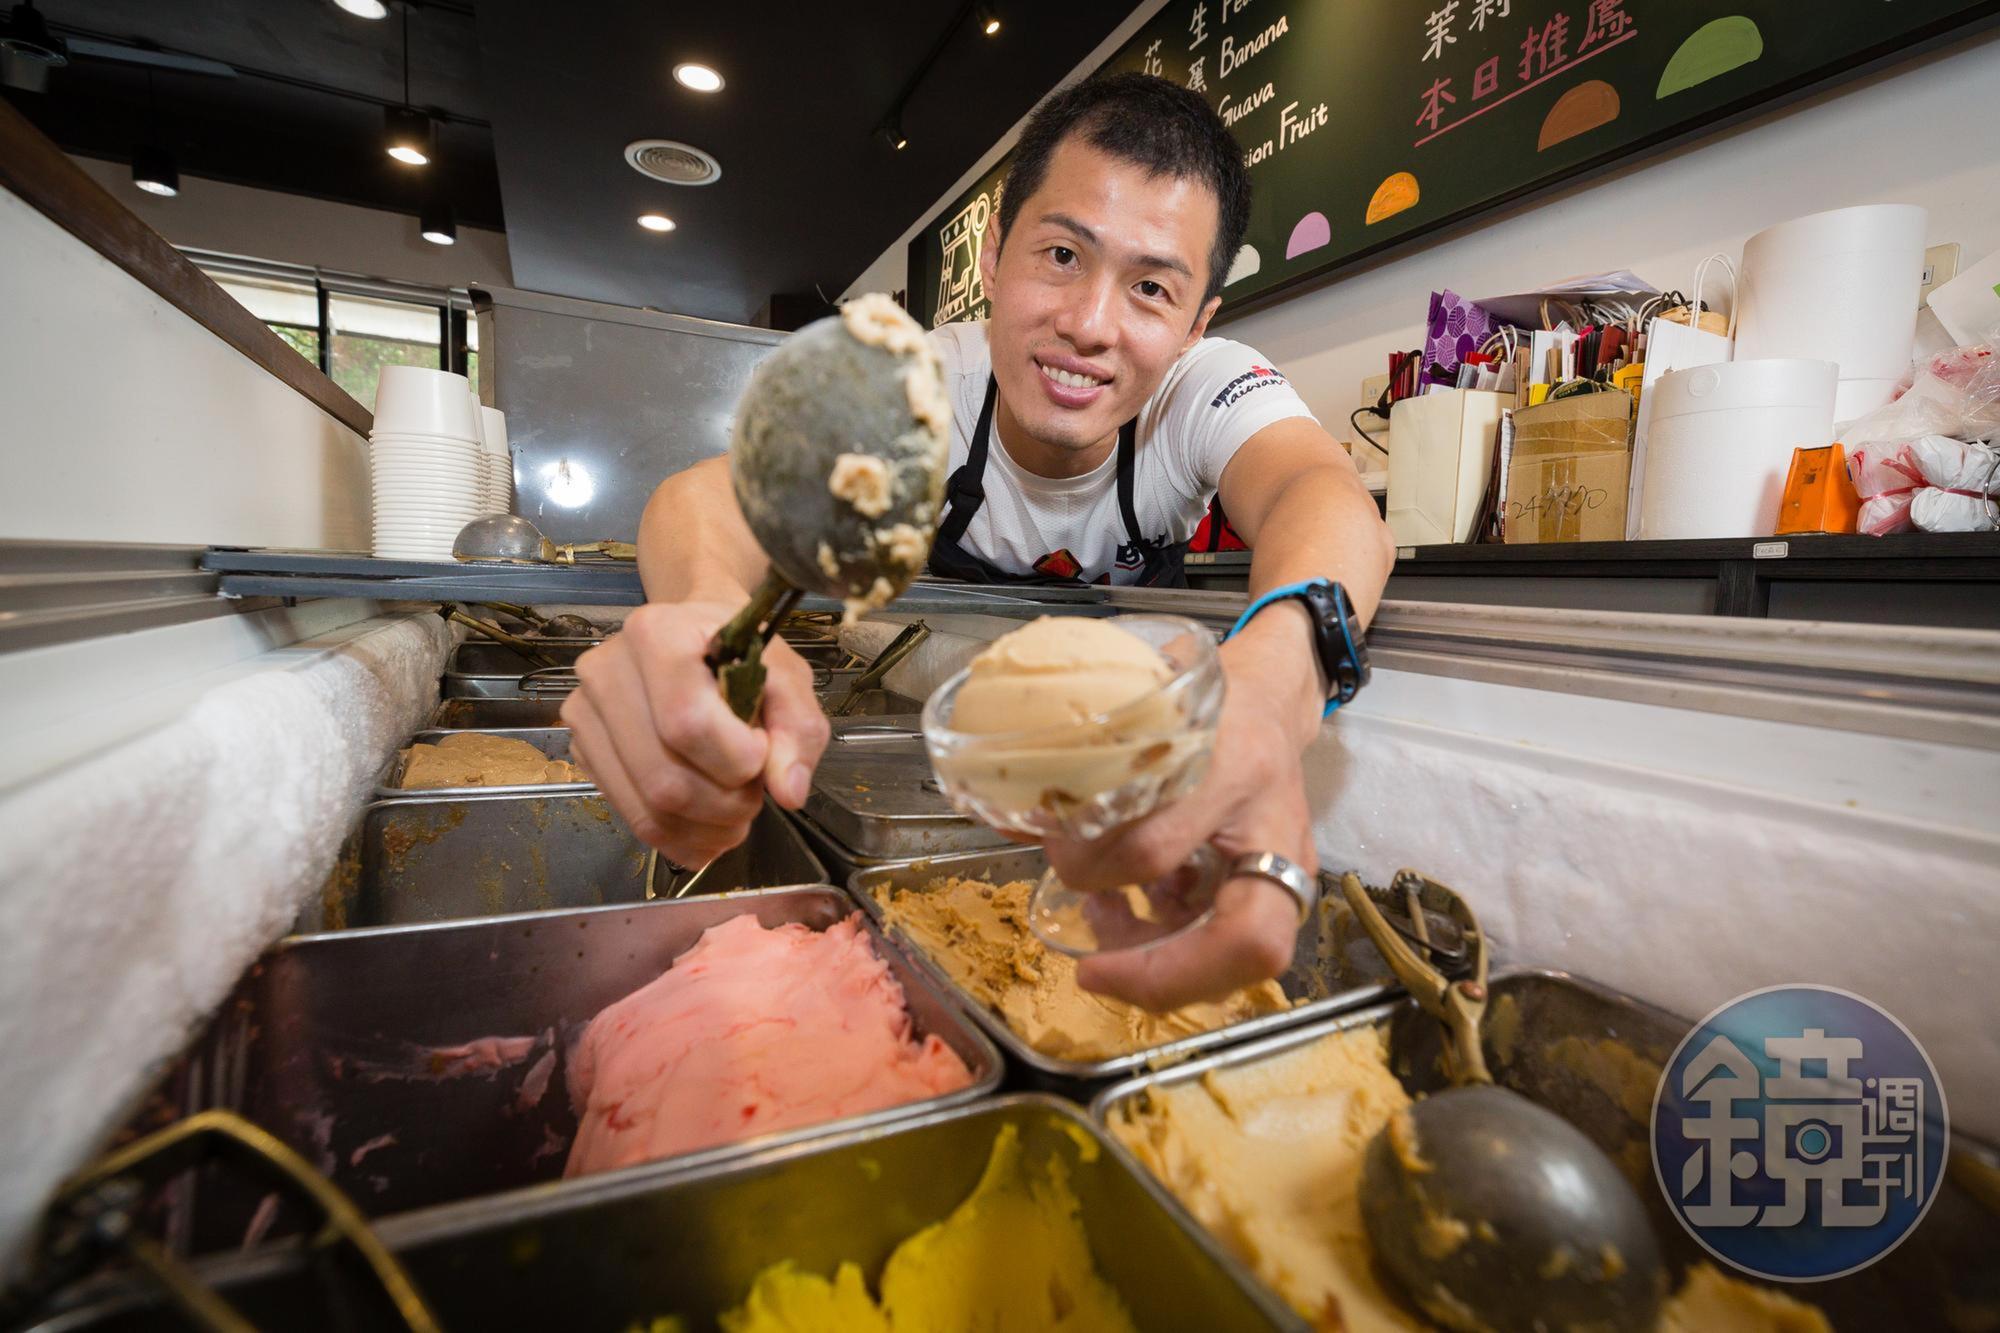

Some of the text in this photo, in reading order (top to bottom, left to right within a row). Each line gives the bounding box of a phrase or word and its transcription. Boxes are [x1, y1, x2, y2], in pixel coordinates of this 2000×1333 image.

[1220, 15, 1289, 79] Banana
[1415, 0, 1633, 130] 本日推薦
[1217, 82, 1276, 128] Guava
[1280, 101, 1329, 151] Fruit
